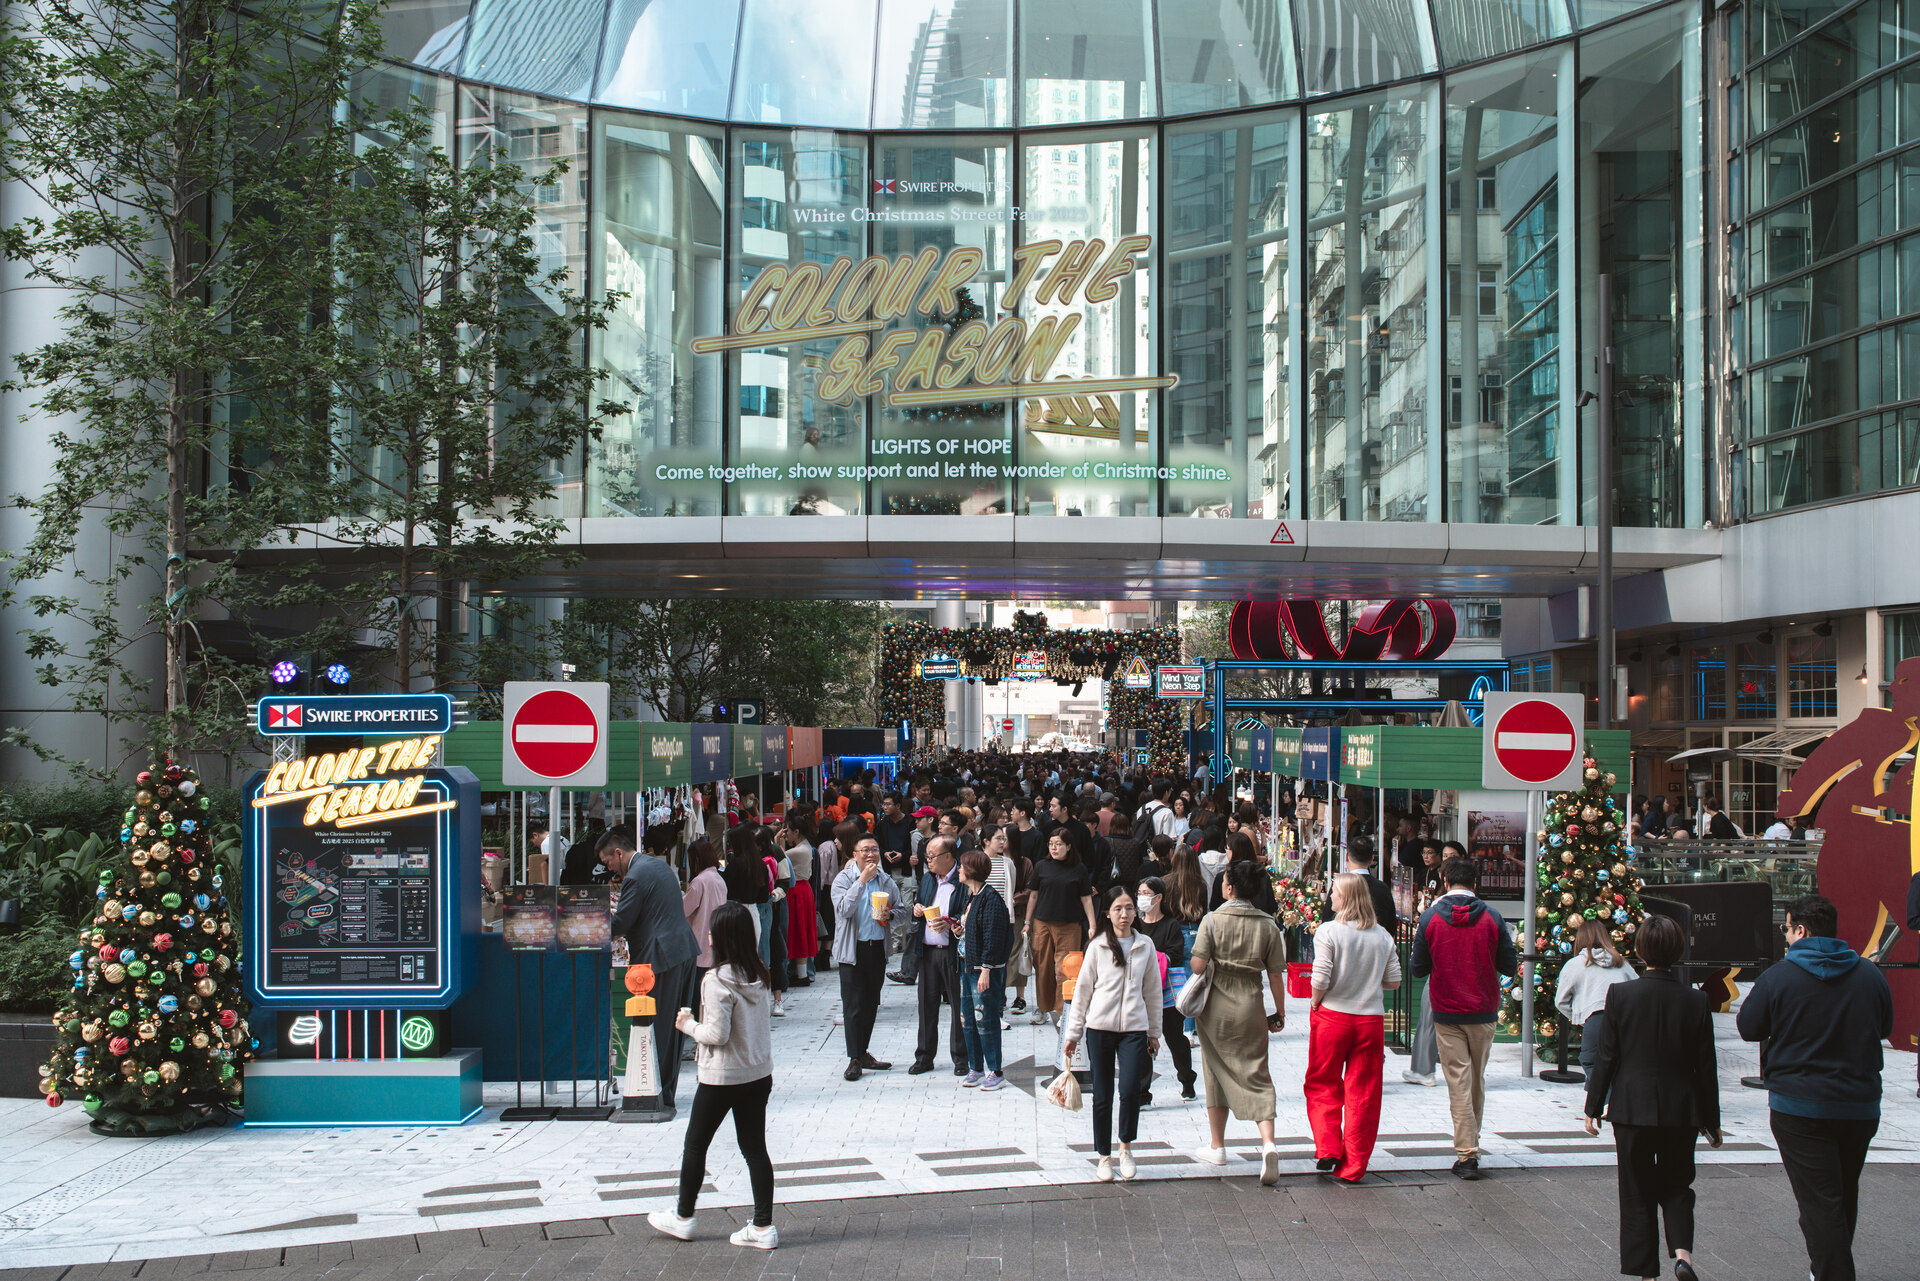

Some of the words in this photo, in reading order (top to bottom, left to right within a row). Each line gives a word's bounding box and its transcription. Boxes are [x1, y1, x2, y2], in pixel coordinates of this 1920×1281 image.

[900, 180, 938, 193] SWIRE
[940, 181, 1011, 192] PROPERTIES
[793, 208, 846, 223] White
[851, 207, 945, 222] Christmas
[950, 207, 1004, 221] Street
[1009, 207, 1046, 221] Fair
[734, 246, 983, 336] COLOUR
[1000, 234, 1152, 309] THE
[818, 312, 1082, 402] SEASON
[871, 439, 931, 455] LIGHTS
[936, 439, 959, 455] OF
[964, 439, 1012, 455] HOPE
[655, 465, 704, 480] Come
[708, 463, 783, 482] together,
[788, 463, 833, 479] show
[837, 463, 902, 481] support
[906, 462, 942, 478] and
[945, 462, 966, 478] let
[970, 462, 998, 478] the
[1002, 462, 1067, 478] wonder
[1071, 462, 1090, 478] of
[1093, 463, 1177, 480] Christmas
[1182, 464, 1232, 481] shine.
[1184, 682, 1200, 691] Step
[306, 708, 352, 723] SWIRE
[354, 708, 439, 722] PROPERTIES
[738, 704, 757, 724] P
[264, 747, 377, 795] COLOUR
[376, 735, 441, 775] THE
[303, 775, 424, 826] SEASON
